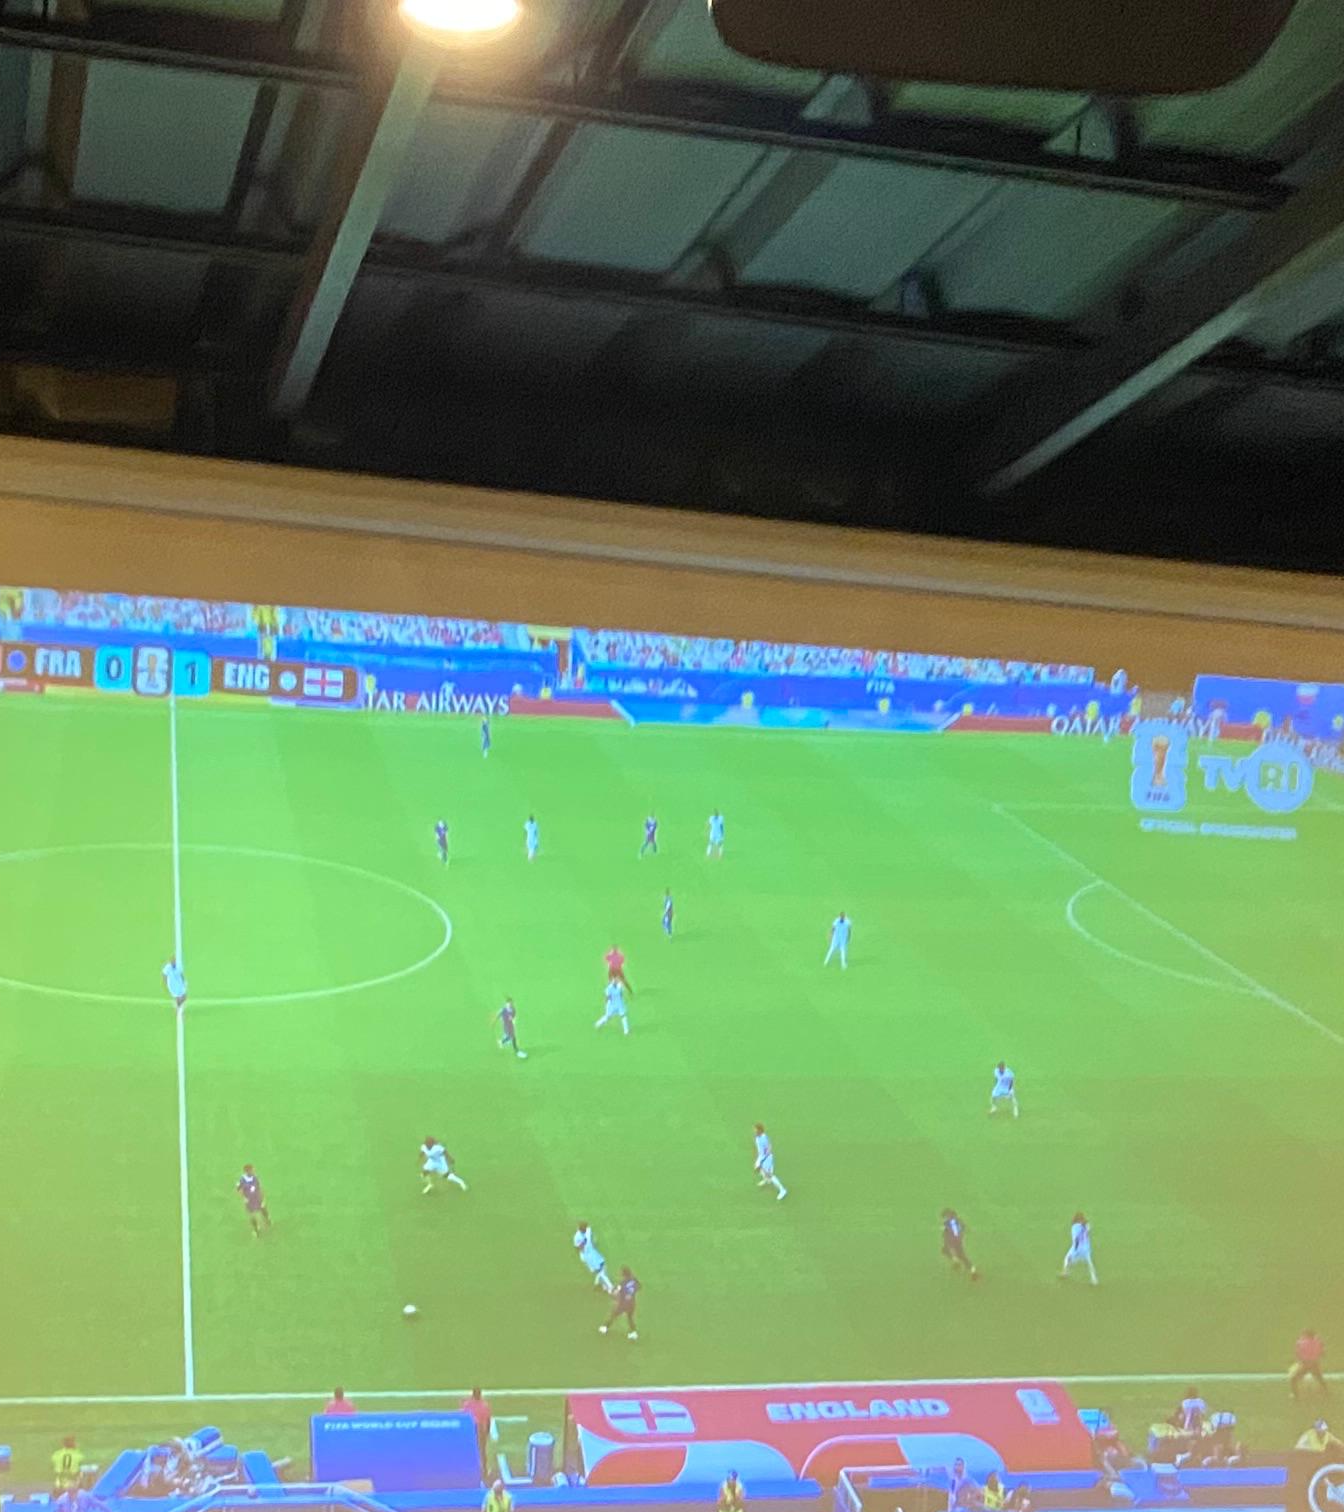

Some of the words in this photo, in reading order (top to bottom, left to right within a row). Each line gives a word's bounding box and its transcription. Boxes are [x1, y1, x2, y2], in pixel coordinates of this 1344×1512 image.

[35, 649, 81, 677] FRA
[106, 655, 122, 681] 0
[185, 661, 197, 687] 1
[224, 662, 270, 691] ENG
[416, 692, 509, 716] AIRWAYS
[766, 1399, 951, 1423] ENGLAND
